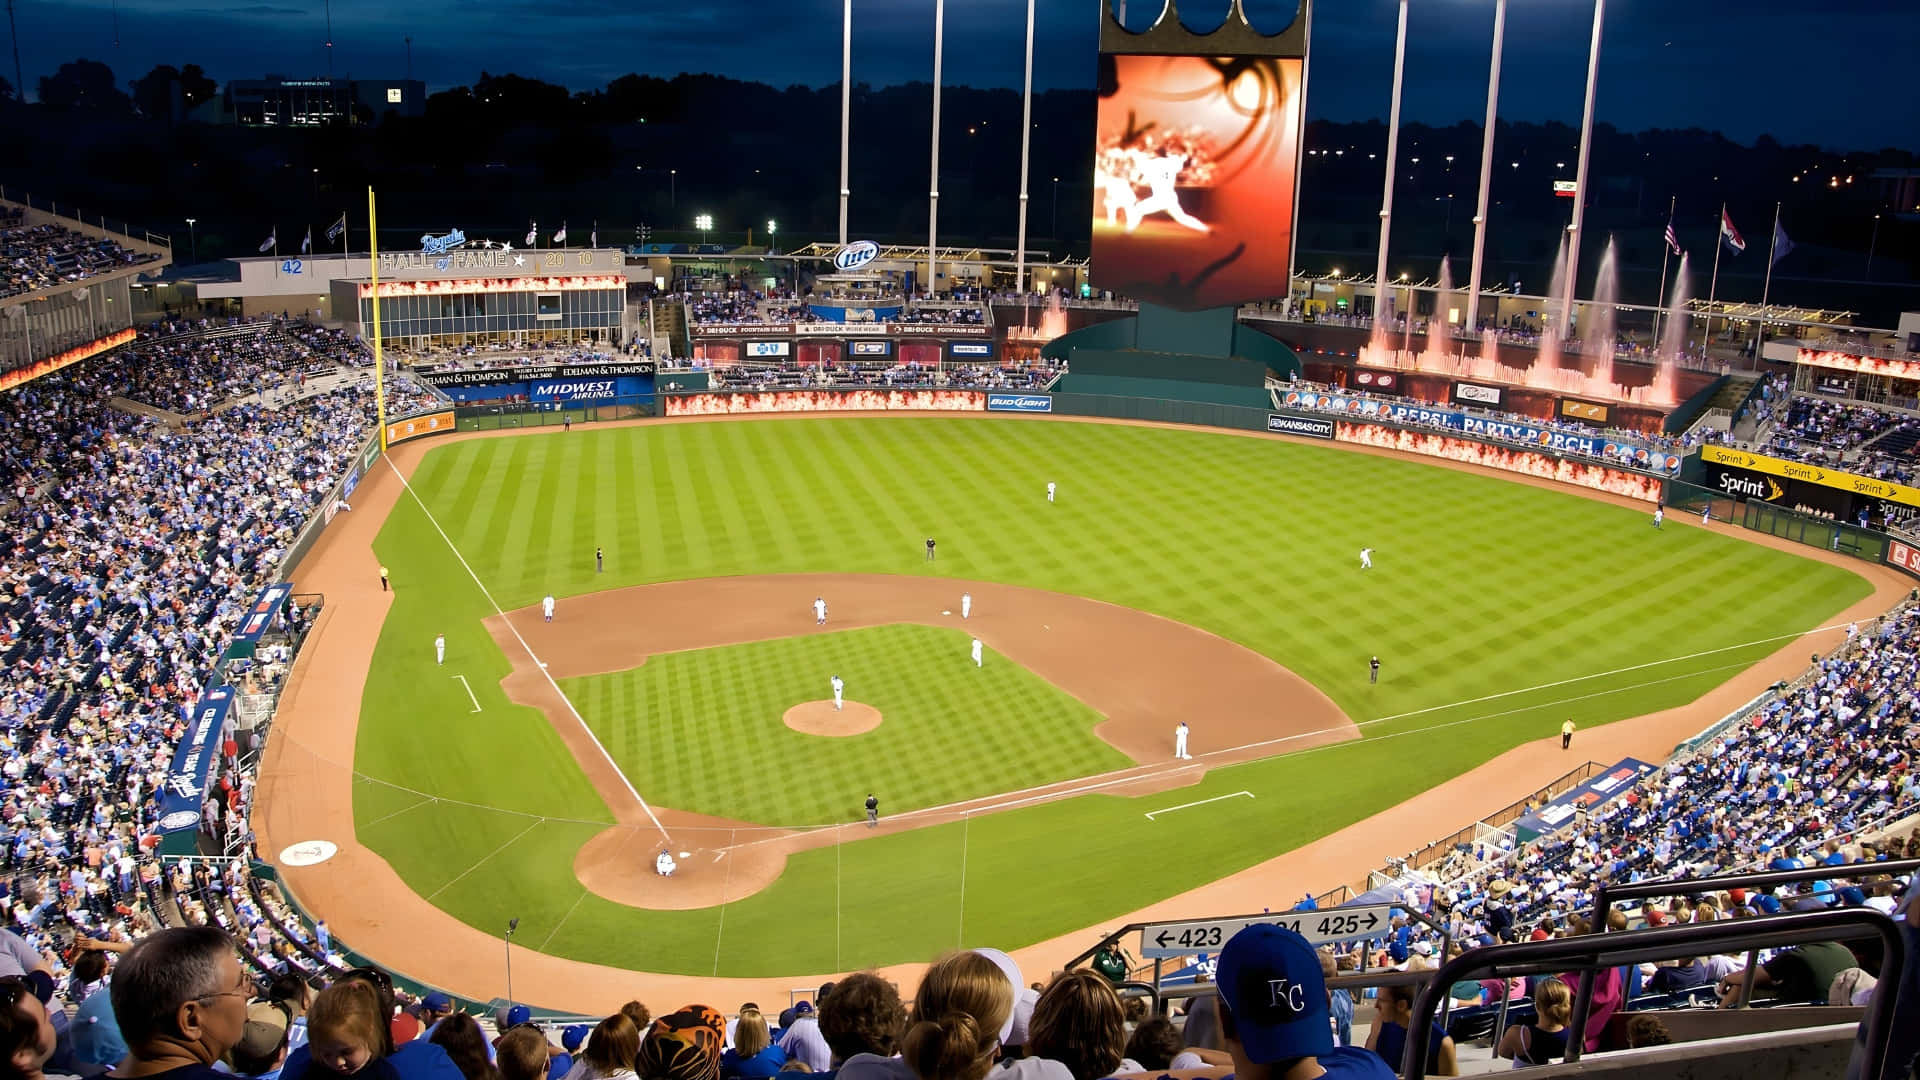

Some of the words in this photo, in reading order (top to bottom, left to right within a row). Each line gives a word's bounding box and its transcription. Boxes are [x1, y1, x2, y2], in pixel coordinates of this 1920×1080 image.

[380, 253, 433, 270] HALL
[453, 250, 508, 268] FAME
[545, 252, 565, 267] 20
[578, 252, 593, 266] 10
[611, 250, 621, 265] 5
[844, 249, 874, 267] Lite
[281, 259, 303, 274] 42
[463, 371, 509, 381] THOMPSON
[563, 367, 598, 376] EDELMAN
[600, 367, 608, 375] &
[608, 365, 653, 374] THOMPSON
[536, 381, 615, 395] MIDWEST
[570, 389, 615, 400] AIRLINES
[1281, 419, 1312, 431] KANSAS
[1313, 424, 1330, 433] CITY
[1463, 418, 1522, 438] PARTY
[1716, 451, 1742, 465] Sprint
[1784, 465, 1811, 479] Sprint
[1719, 472, 1765, 497] Sprint
[1854, 479, 1883, 495] Sprint
[1879, 500, 1917, 520] Sprint
[1317, 915, 1359, 936] 425
[1178, 926, 1222, 948] 423
[1267, 978, 1305, 1012] KC
